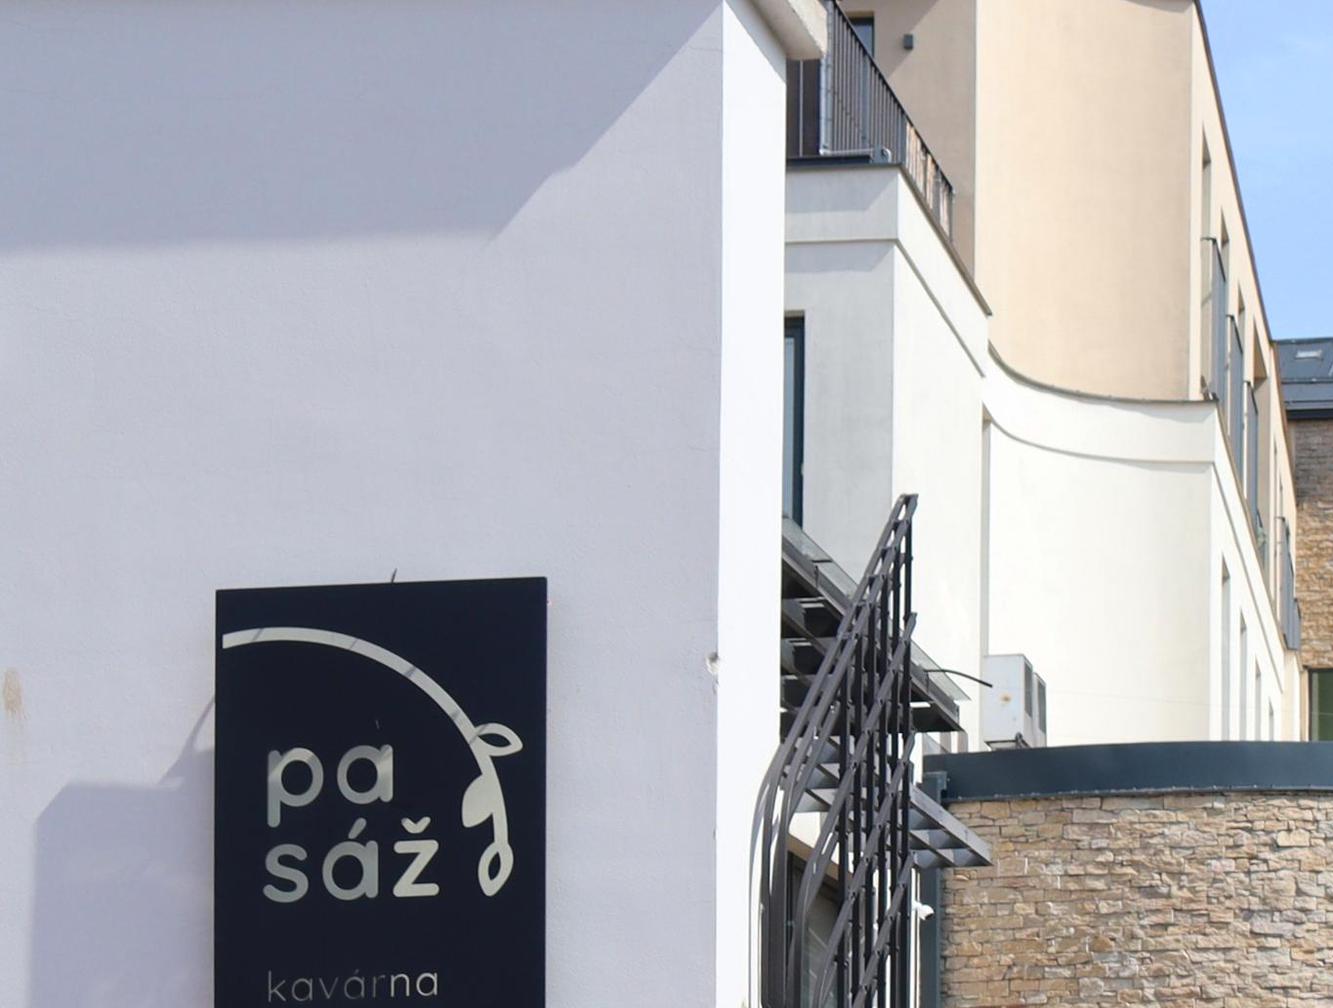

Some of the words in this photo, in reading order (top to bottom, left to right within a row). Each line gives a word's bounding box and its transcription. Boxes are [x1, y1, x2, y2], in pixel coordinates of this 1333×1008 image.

[267, 744, 393, 827] pa
[263, 817, 439, 902] sáž
[267, 970, 438, 1002] kavárna
